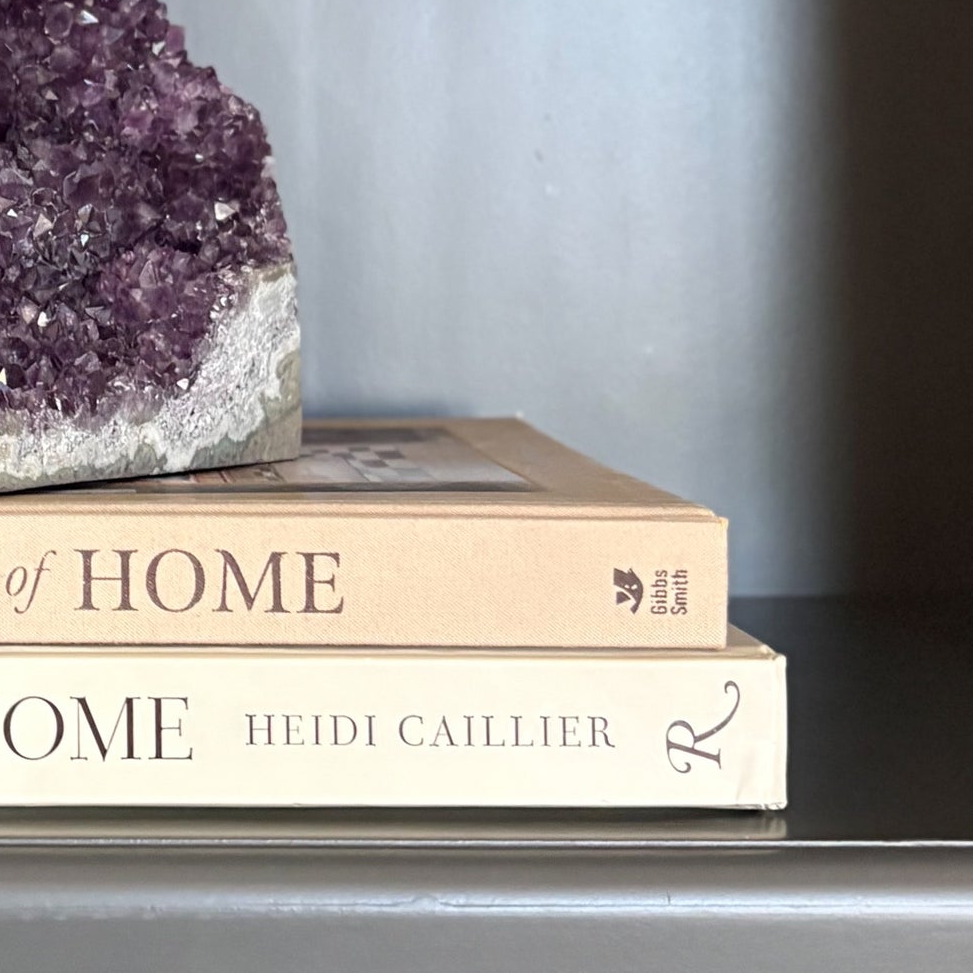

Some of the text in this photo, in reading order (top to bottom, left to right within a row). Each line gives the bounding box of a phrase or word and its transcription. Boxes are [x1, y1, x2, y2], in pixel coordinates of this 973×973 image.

[5, 550, 57, 614] of
[74, 548, 344, 614] HOME
[651, 569, 668, 615] Gibbs
[670, 569, 689, 616] Smith
[245, 713, 616, 748] HEIDI CAILLIER
[665, 680, 741, 773] R
